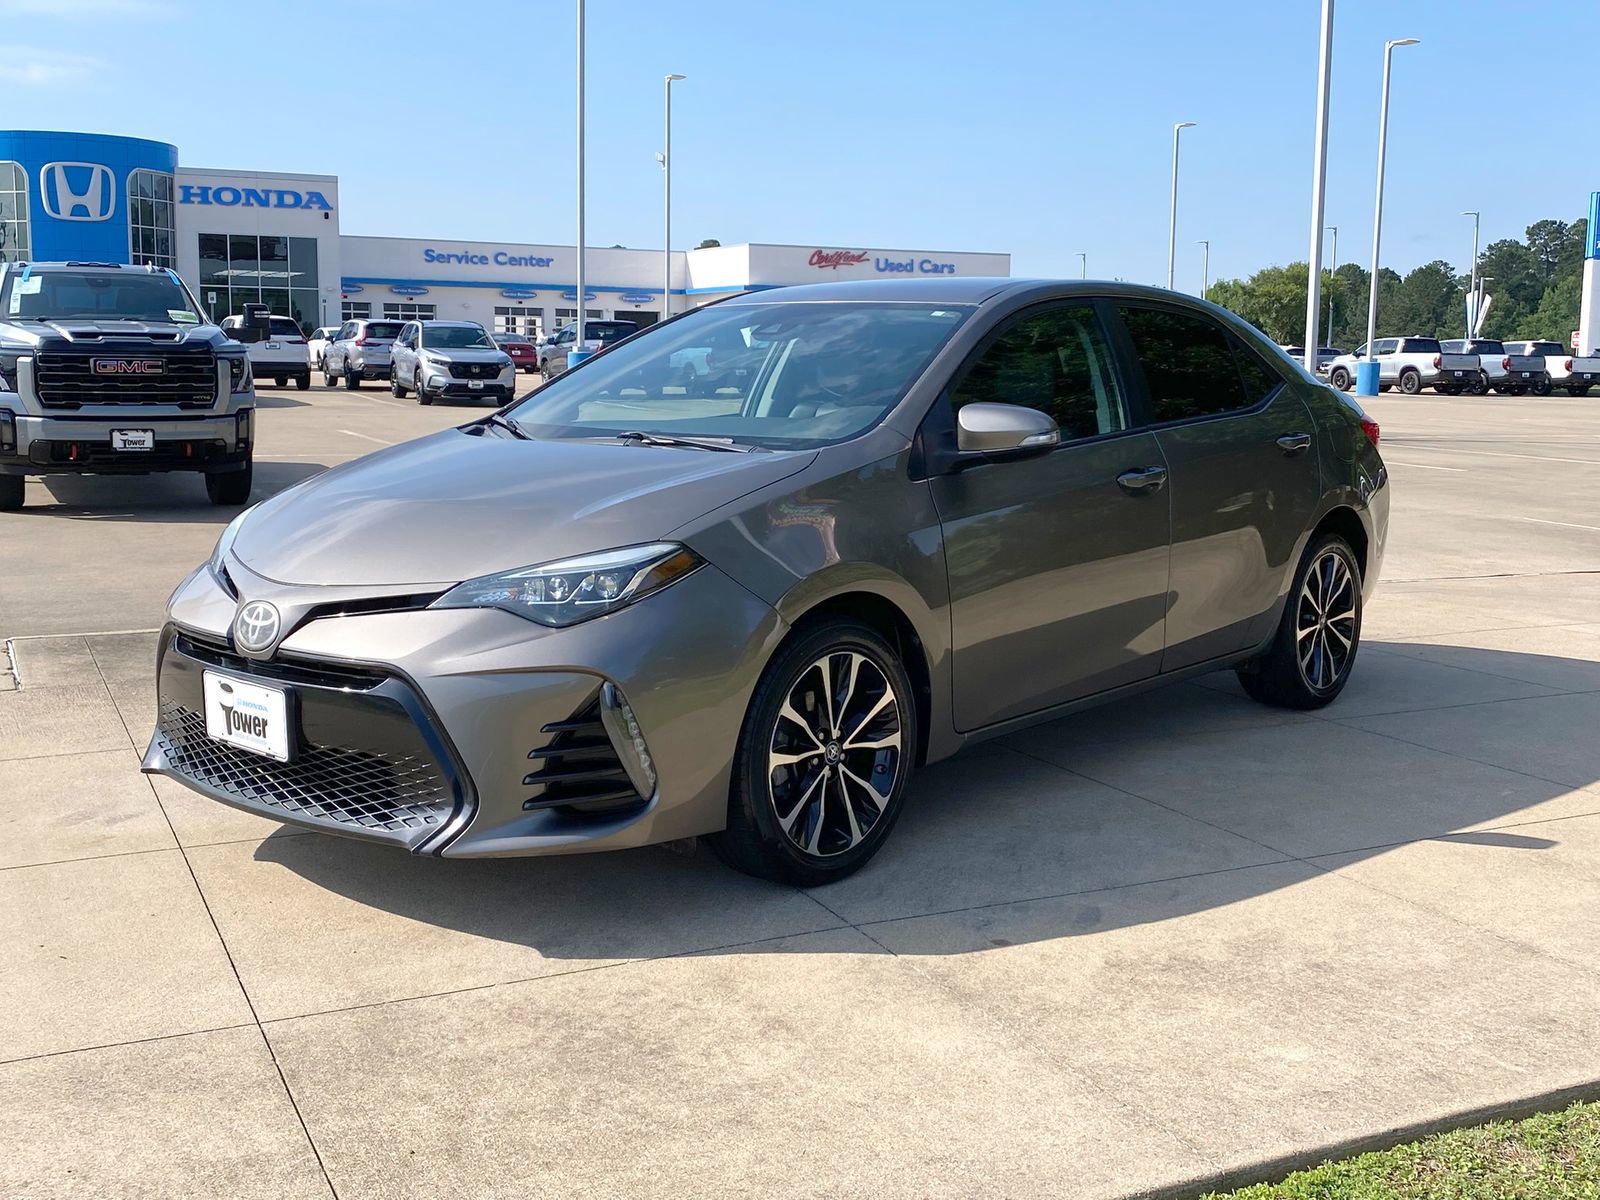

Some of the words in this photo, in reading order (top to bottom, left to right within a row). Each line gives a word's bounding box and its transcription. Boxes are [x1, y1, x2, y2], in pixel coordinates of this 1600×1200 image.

[179, 185, 333, 210] HONDA
[424, 249, 489, 265] Service
[494, 252, 554, 267] Center
[875, 258, 914, 272] Used
[919, 259, 955, 273] Cars
[96, 360, 162, 373] GMC
[119, 438, 146, 448] Tower
[242, 700, 269, 712] HONDA
[219, 702, 268, 739] Tower
